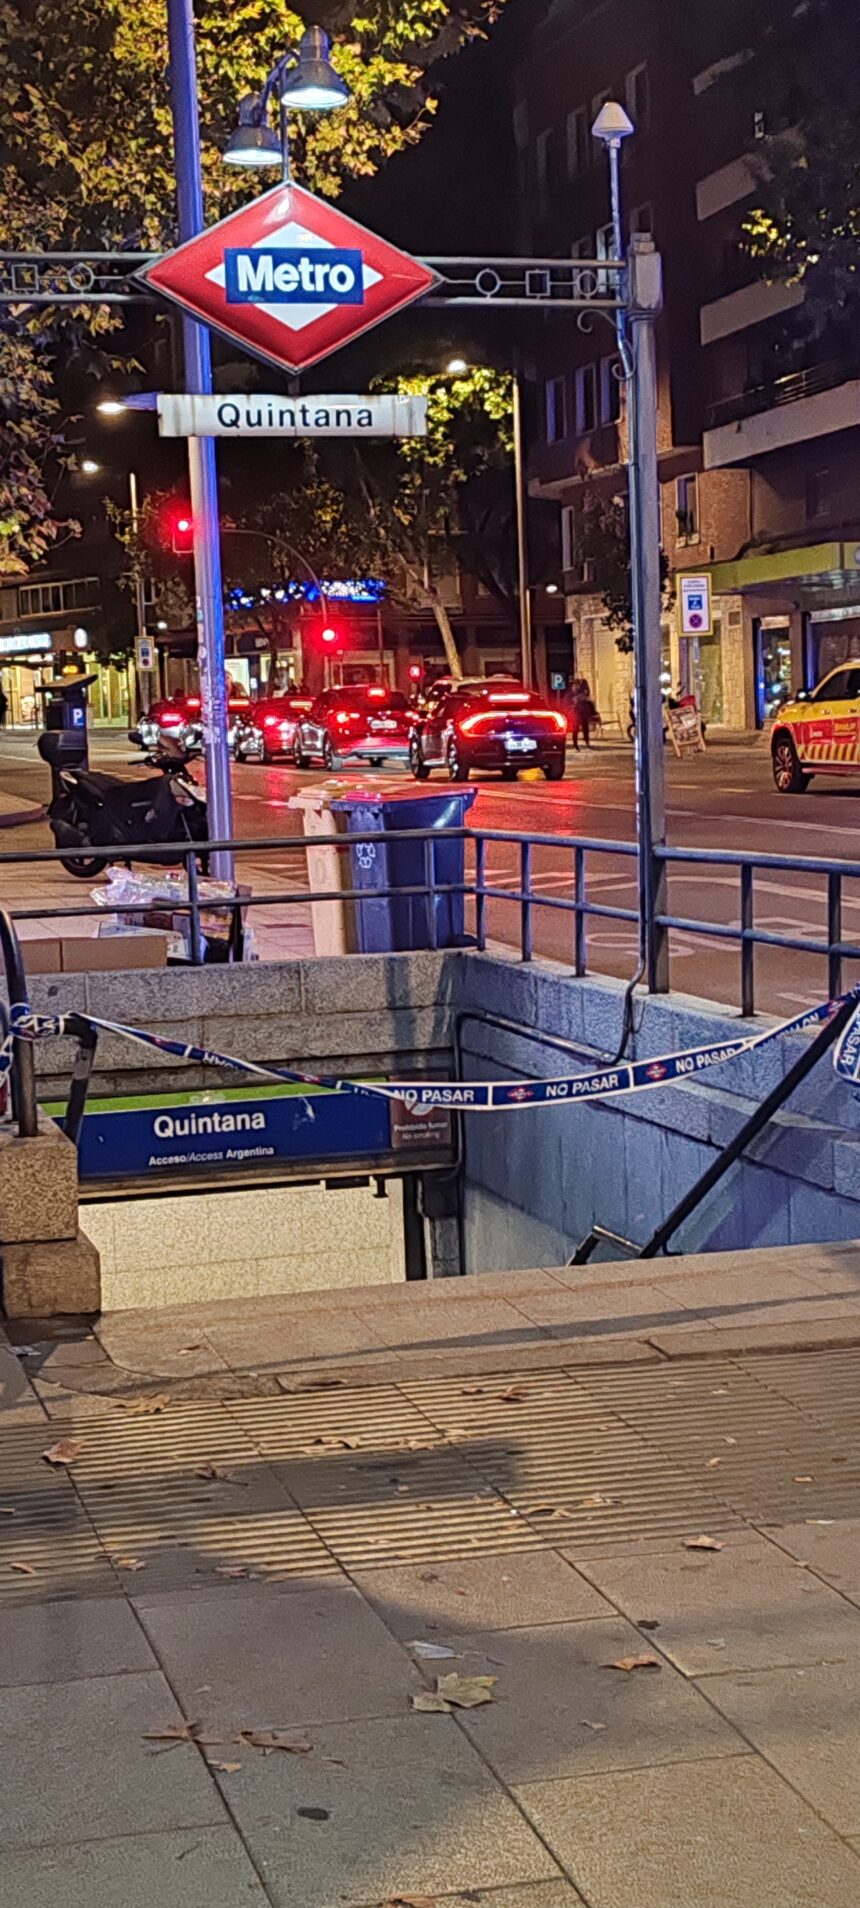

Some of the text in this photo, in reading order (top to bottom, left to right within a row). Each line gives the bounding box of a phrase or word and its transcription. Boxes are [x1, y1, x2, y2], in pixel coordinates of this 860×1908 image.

[236, 254, 356, 293] Metro
[217, 402, 374, 430] Quintana
[554, 673, 564, 688] P
[73, 708, 84, 724] P
[675, 1057, 695, 1074] NO
[421, 1089, 475, 1103] PASAR
[545, 1083, 569, 1098] NO
[571, 1073, 619, 1095] PASAR
[153, 1111, 266, 1138] Quintana
[148, 1145, 275, 1167] Acceso/Access Argentina
